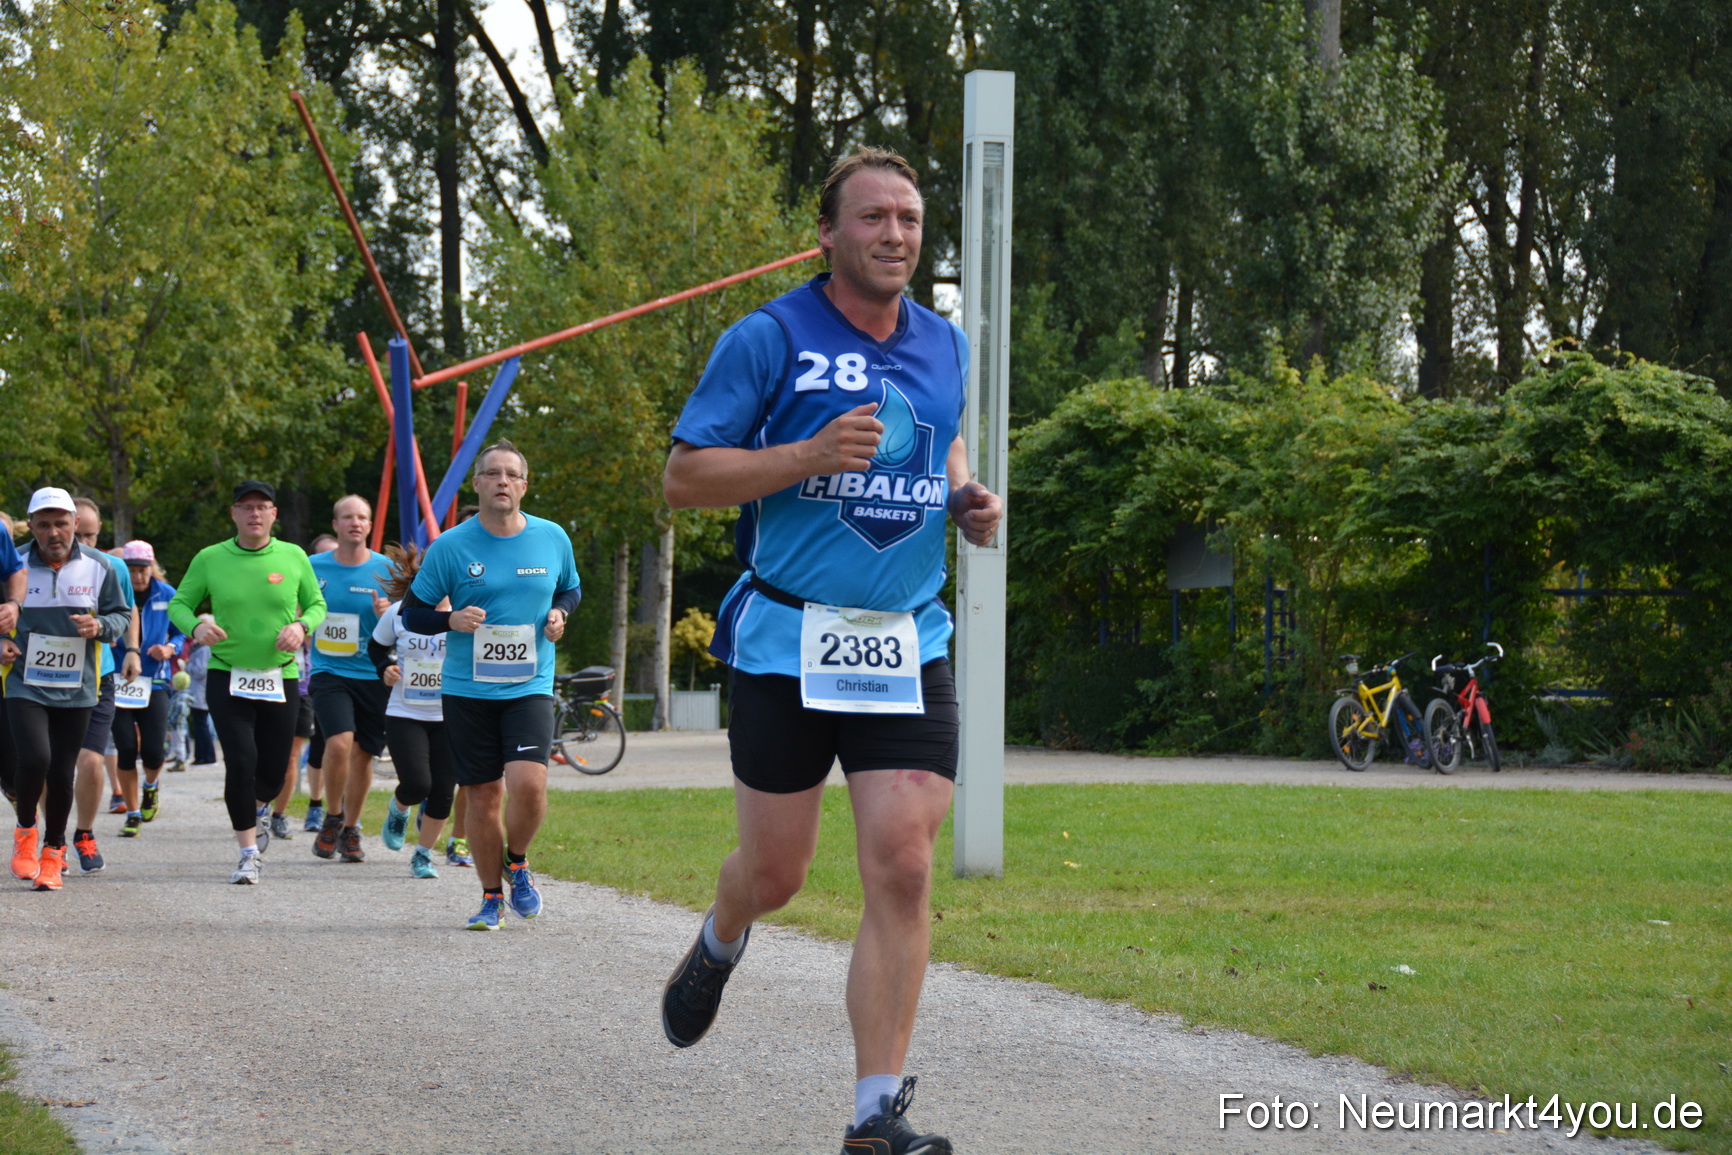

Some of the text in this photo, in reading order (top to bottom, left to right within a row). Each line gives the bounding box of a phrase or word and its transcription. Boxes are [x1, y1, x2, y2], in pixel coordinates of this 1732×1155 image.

[795, 351, 868, 392] 28
[804, 472, 945, 505] FIBALON
[853, 506, 917, 521] BASKETS
[516, 567, 547, 575] BOCK
[324, 625, 347, 640] 408
[483, 643, 527, 660] 2932
[820, 632, 903, 669] 2383
[35, 650, 76, 668] 2210
[238, 677, 275, 692] 2493
[836, 679, 889, 693] Christian
